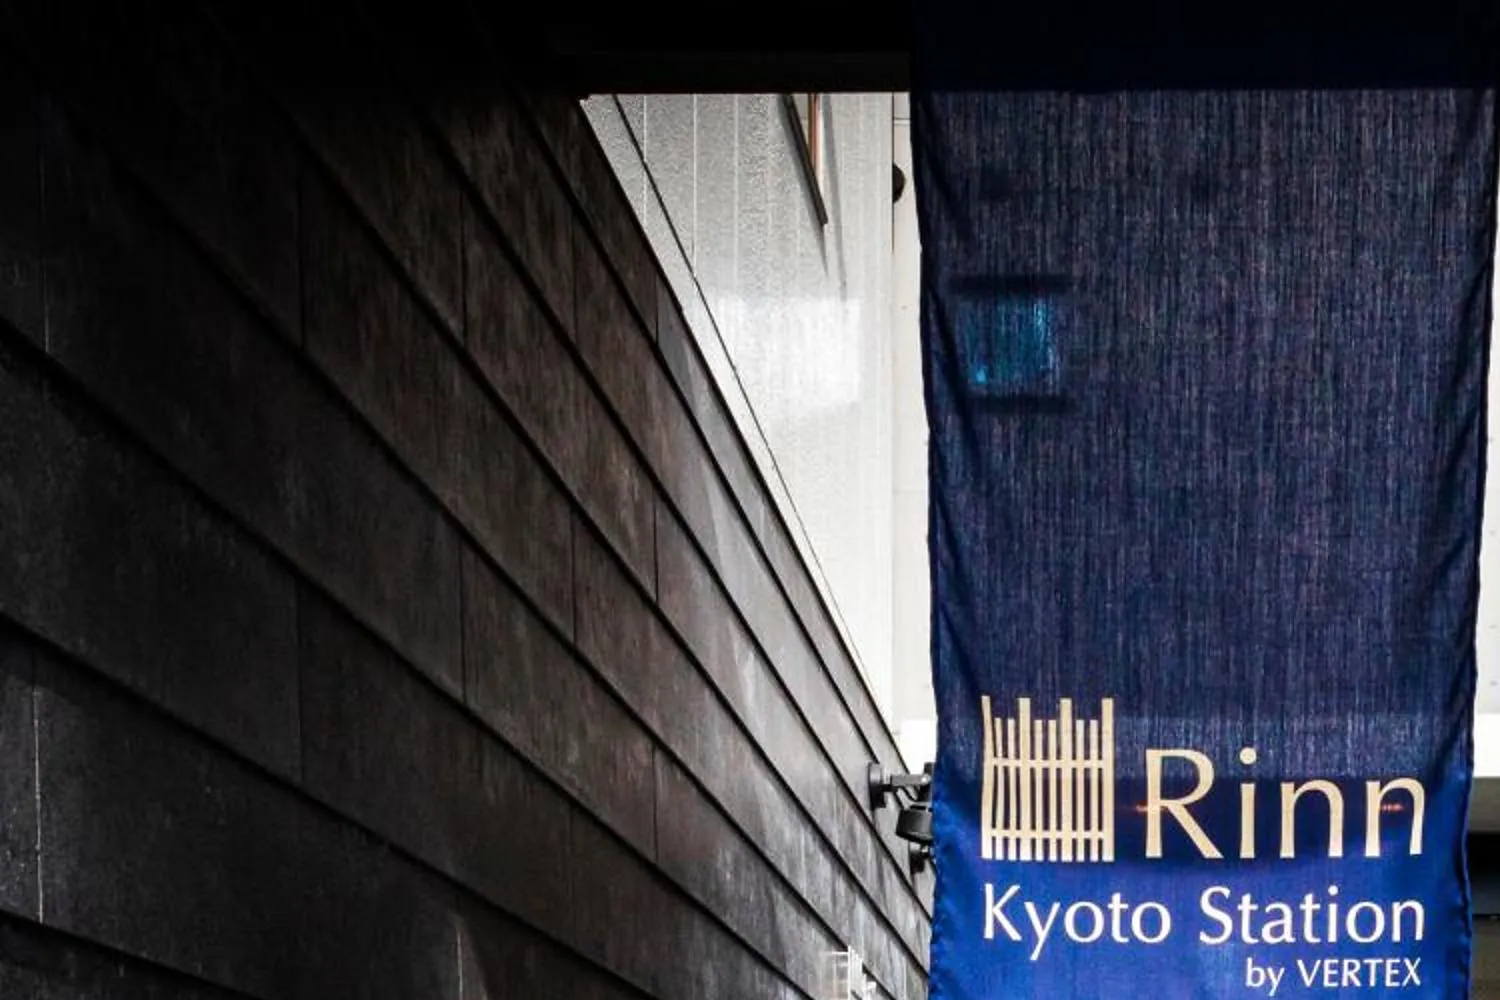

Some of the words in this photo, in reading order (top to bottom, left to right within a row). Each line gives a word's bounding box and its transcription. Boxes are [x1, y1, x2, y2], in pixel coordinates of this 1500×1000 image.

[1144, 747, 1425, 859] Rinn
[983, 883, 1171, 961] Kyoto
[1199, 885, 1425, 945] Station
[1246, 957, 1285, 997] by
[1297, 957, 1421, 988] VERTEX
